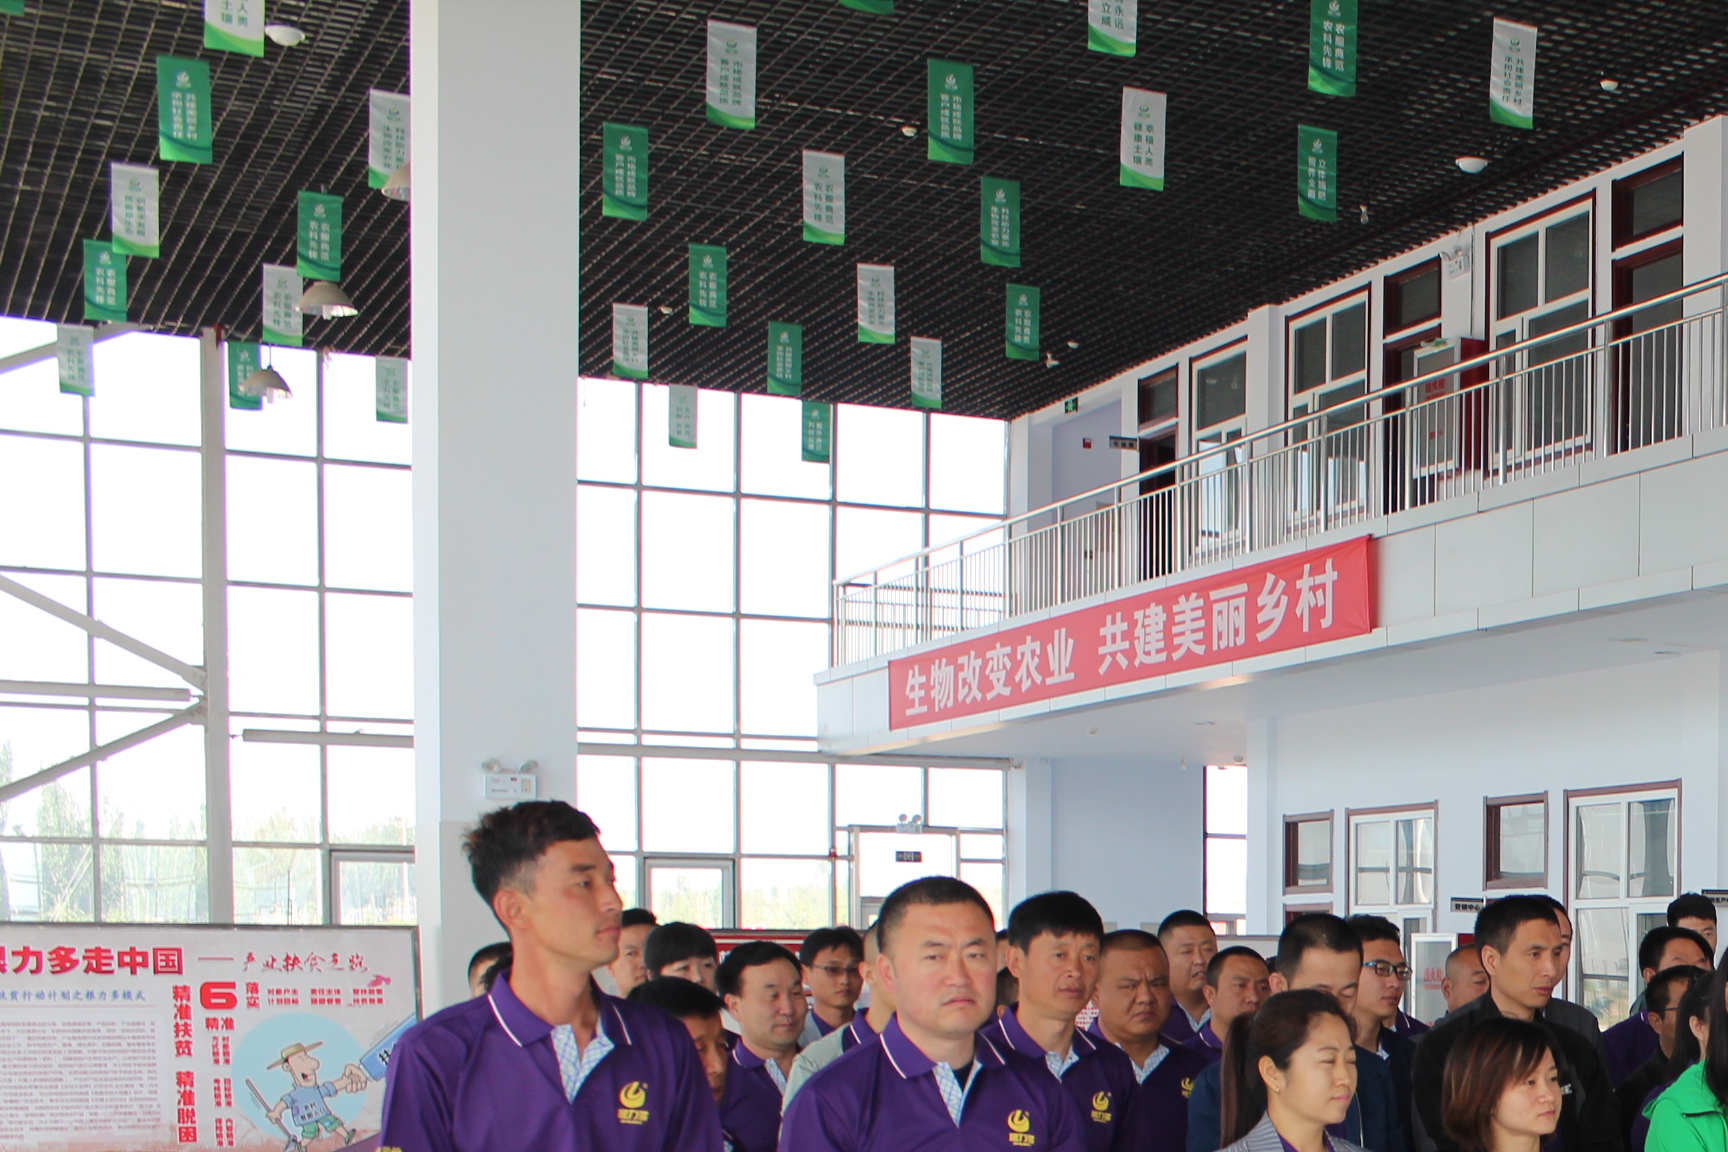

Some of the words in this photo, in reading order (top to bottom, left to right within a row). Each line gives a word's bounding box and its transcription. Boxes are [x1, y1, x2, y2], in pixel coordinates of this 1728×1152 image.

[1322, 20, 1333, 69] 农科先锋
[1335, 22, 1345, 72] 农服典范
[904, 626, 1076, 717] 生物改变农业
[1097, 557, 1339, 677] 共建美丽乡村
[0, 945, 184, 976] 力多走中国
[200, 982, 238, 1011] 6
[173, 985, 194, 1058] 精准扶贫
[205, 1016, 235, 1031] 精准
[176, 1071, 198, 1143] 精准脱困
